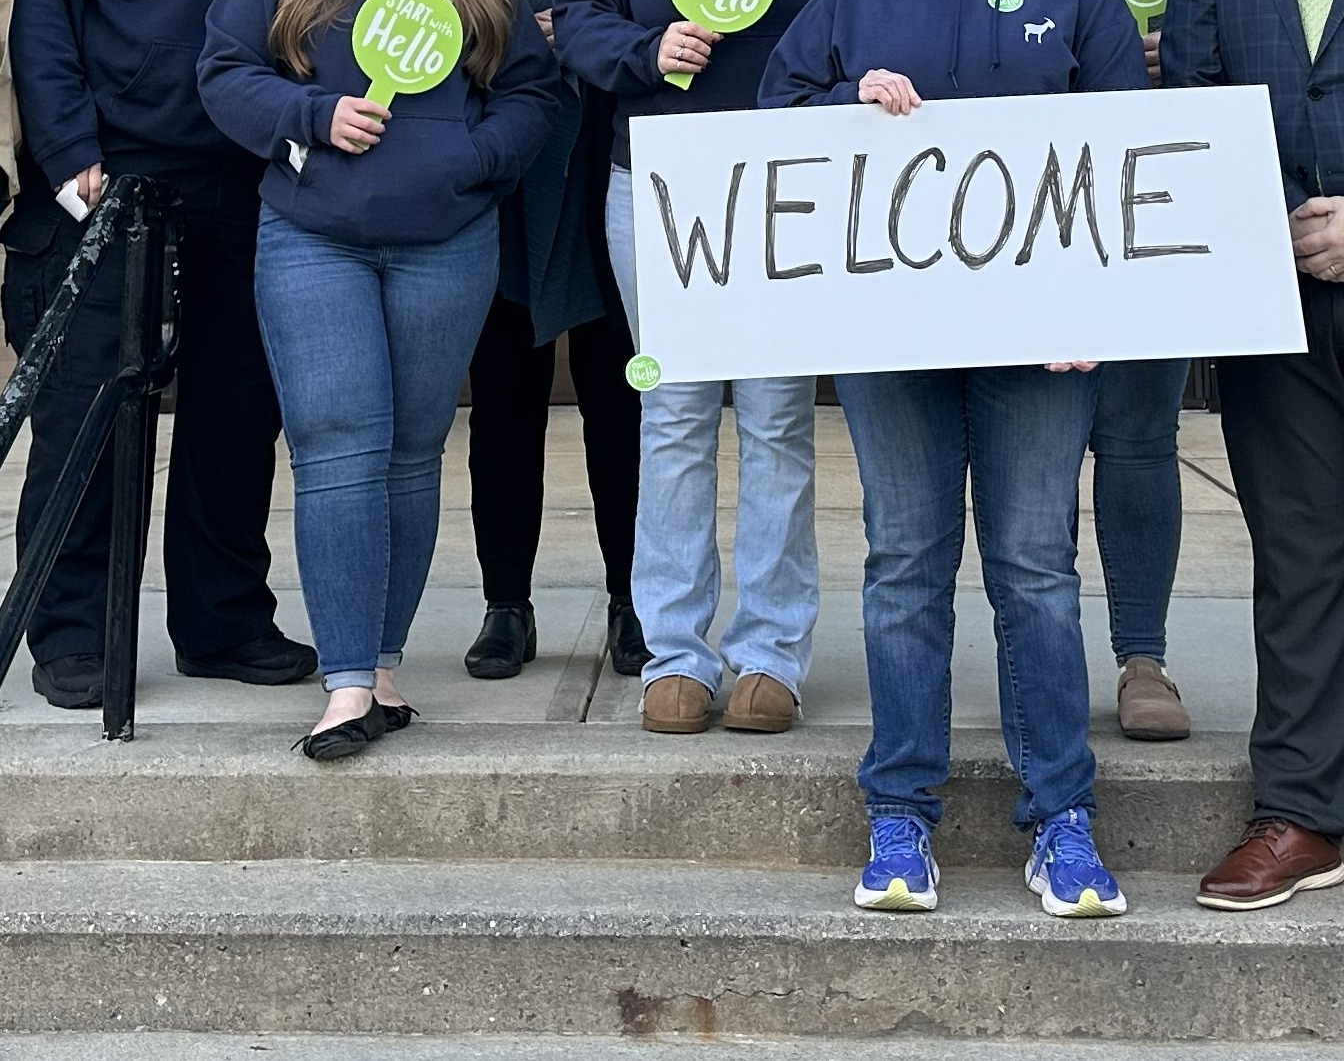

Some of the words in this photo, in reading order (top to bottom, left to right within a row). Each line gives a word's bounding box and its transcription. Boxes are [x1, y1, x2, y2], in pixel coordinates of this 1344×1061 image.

[361, 7, 444, 74] Hello
[429, 19, 453, 38] with
[650, 142, 1210, 289] WELCOME
[631, 365, 659, 383] Hello
